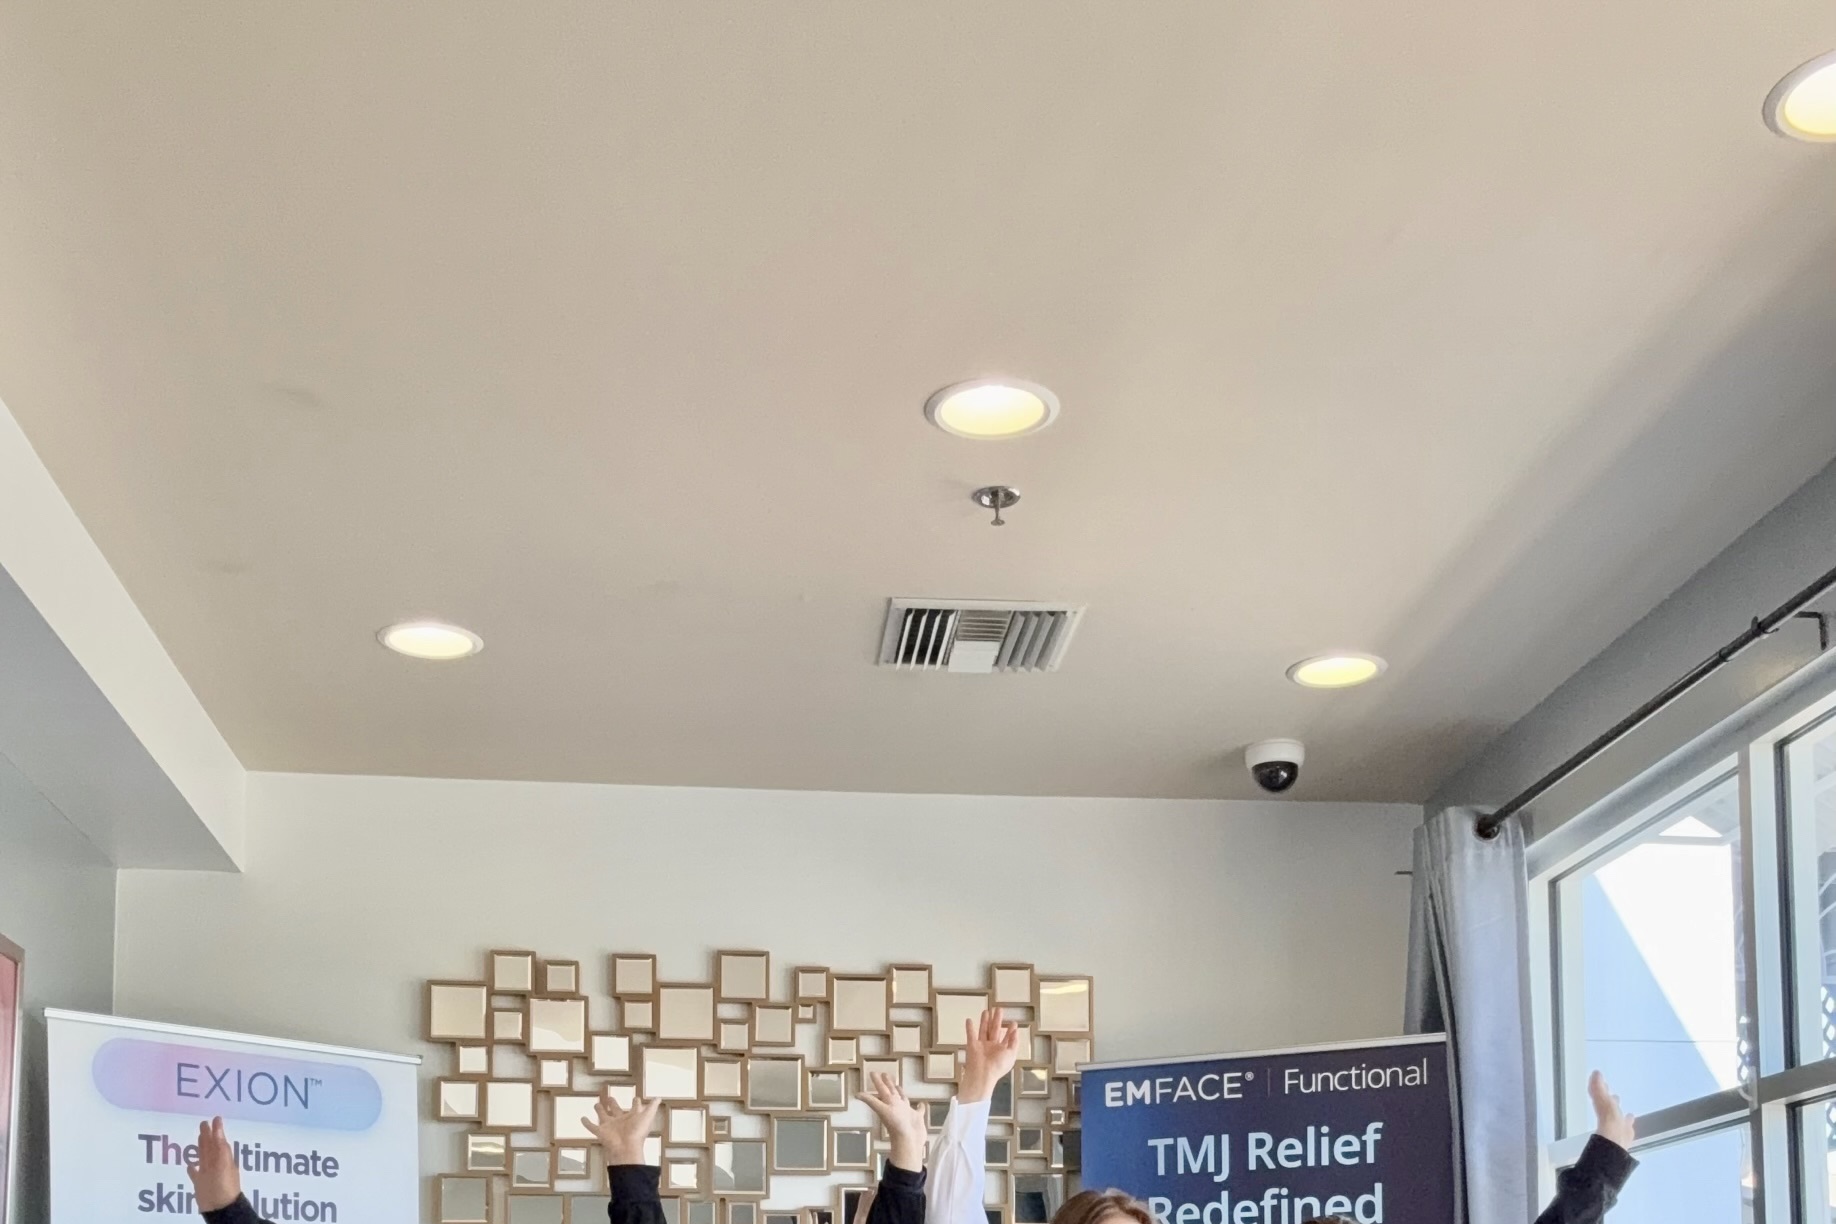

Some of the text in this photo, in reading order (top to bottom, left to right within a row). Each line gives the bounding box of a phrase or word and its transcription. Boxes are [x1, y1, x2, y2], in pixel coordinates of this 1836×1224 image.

[1283, 1058, 1429, 1095] Functional
[138, 1133, 340, 1179] The ltimate
[1147, 1122, 1384, 1183] TMJ Relief
[253, 1189, 338, 1224] lution
